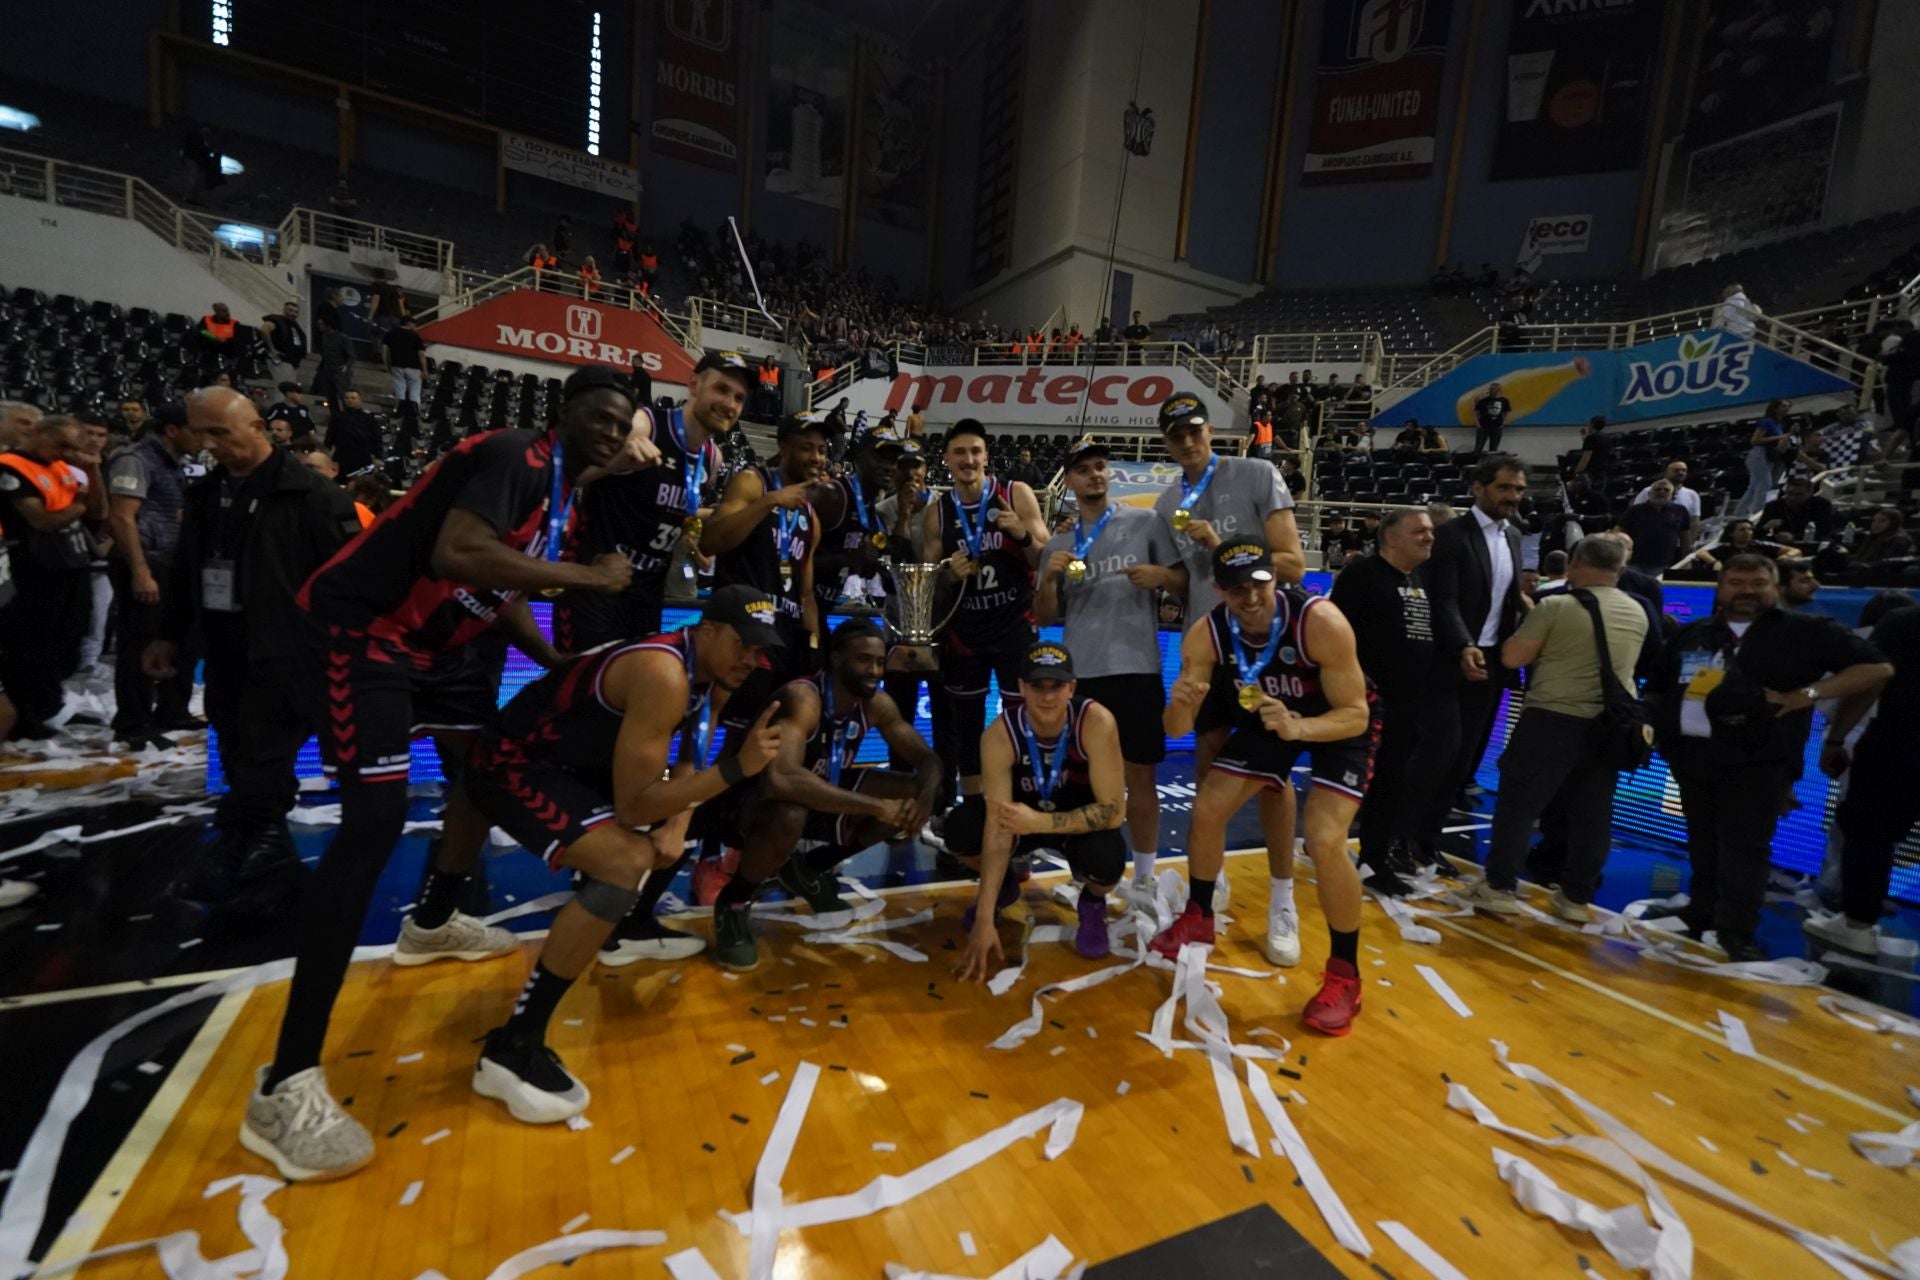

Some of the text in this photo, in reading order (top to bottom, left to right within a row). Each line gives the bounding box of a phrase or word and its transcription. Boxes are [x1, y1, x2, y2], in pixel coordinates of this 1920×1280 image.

[656, 60, 736, 107] MORRIS
[1328, 90, 1422, 124] FUNAI-UNITED
[496, 324, 663, 371] MORRIS
[884, 367, 1174, 412] mateco
[1065, 415, 1120, 425] AIMING
[1109, 469, 1182, 486] λου
[976, 565, 999, 590] 12
